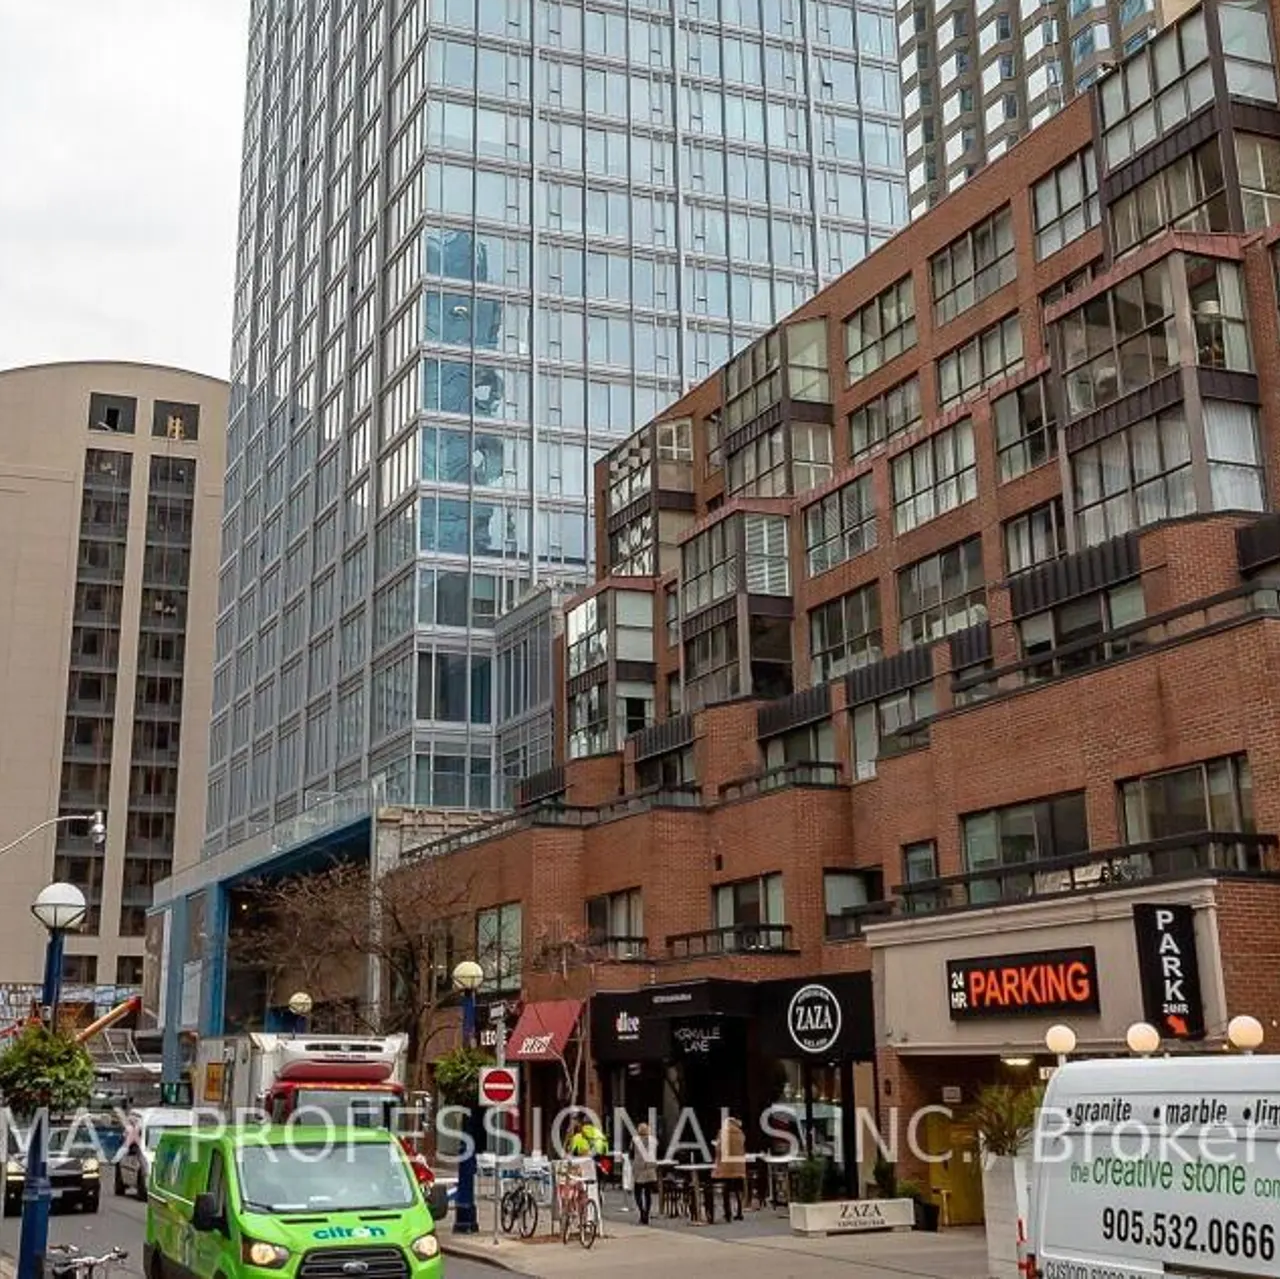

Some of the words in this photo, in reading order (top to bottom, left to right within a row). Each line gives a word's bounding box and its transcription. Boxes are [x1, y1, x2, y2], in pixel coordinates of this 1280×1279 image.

[1156, 910, 1186, 1001] PARK
[951, 971, 965, 989] 24
[970, 961, 1090, 1008] PARKING
[795, 1004, 833, 1030] ZAZA
[951, 992, 968, 1009] HR
[1074, 1098, 1132, 1125] granite
[1166, 1098, 1228, 1124] marble
[1070, 1162, 1090, 1183] the
[1093, 1153, 1173, 1190] creative
[1182, 1156, 1246, 1196] stone
[1102, 1207, 1275, 1261] 905.532.0666
